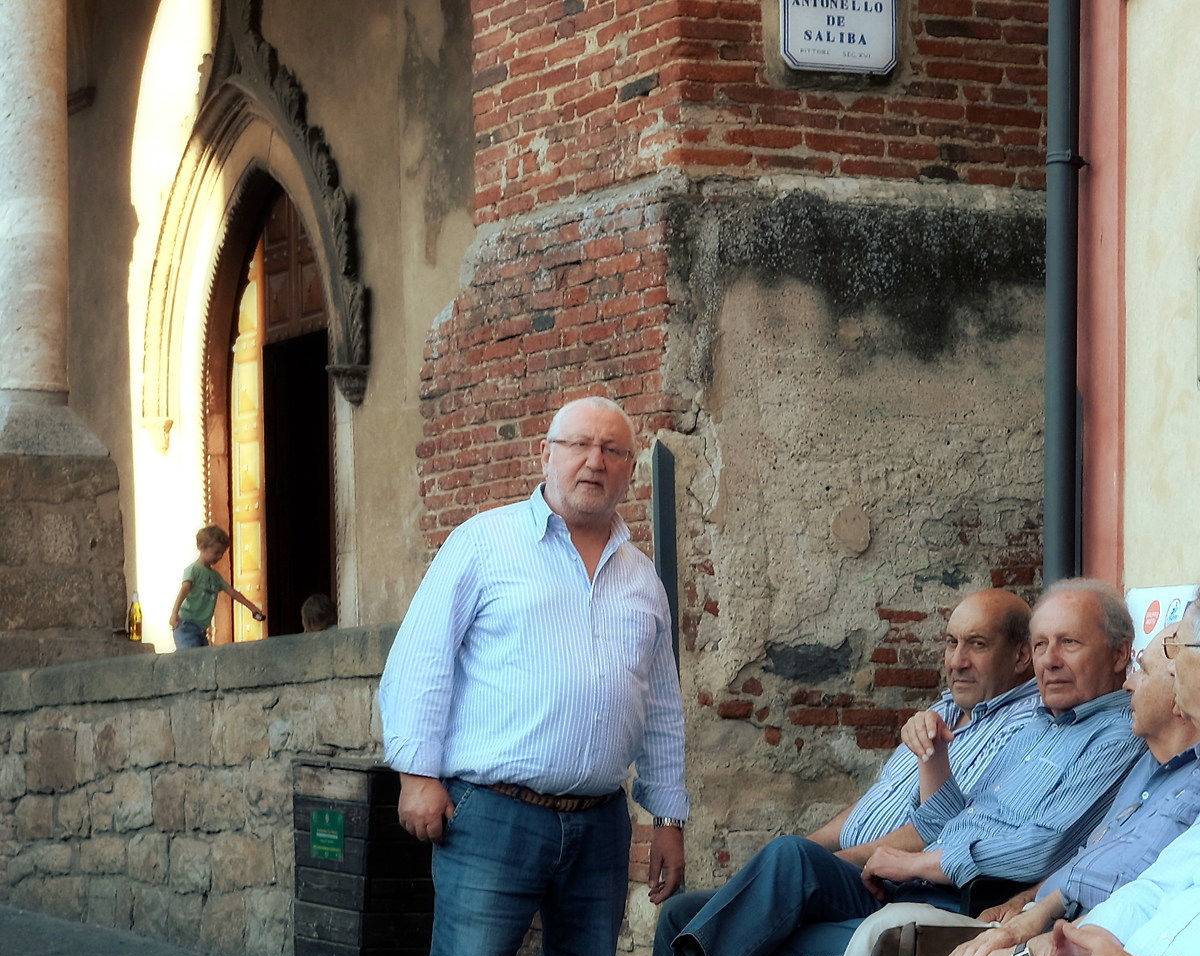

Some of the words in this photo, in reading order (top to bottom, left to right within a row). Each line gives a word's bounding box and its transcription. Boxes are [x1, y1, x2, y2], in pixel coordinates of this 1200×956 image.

[792, 0, 883, 13] ANTONELLO
[826, 15, 845, 27] DE
[803, 30, 867, 45] SALIBA
